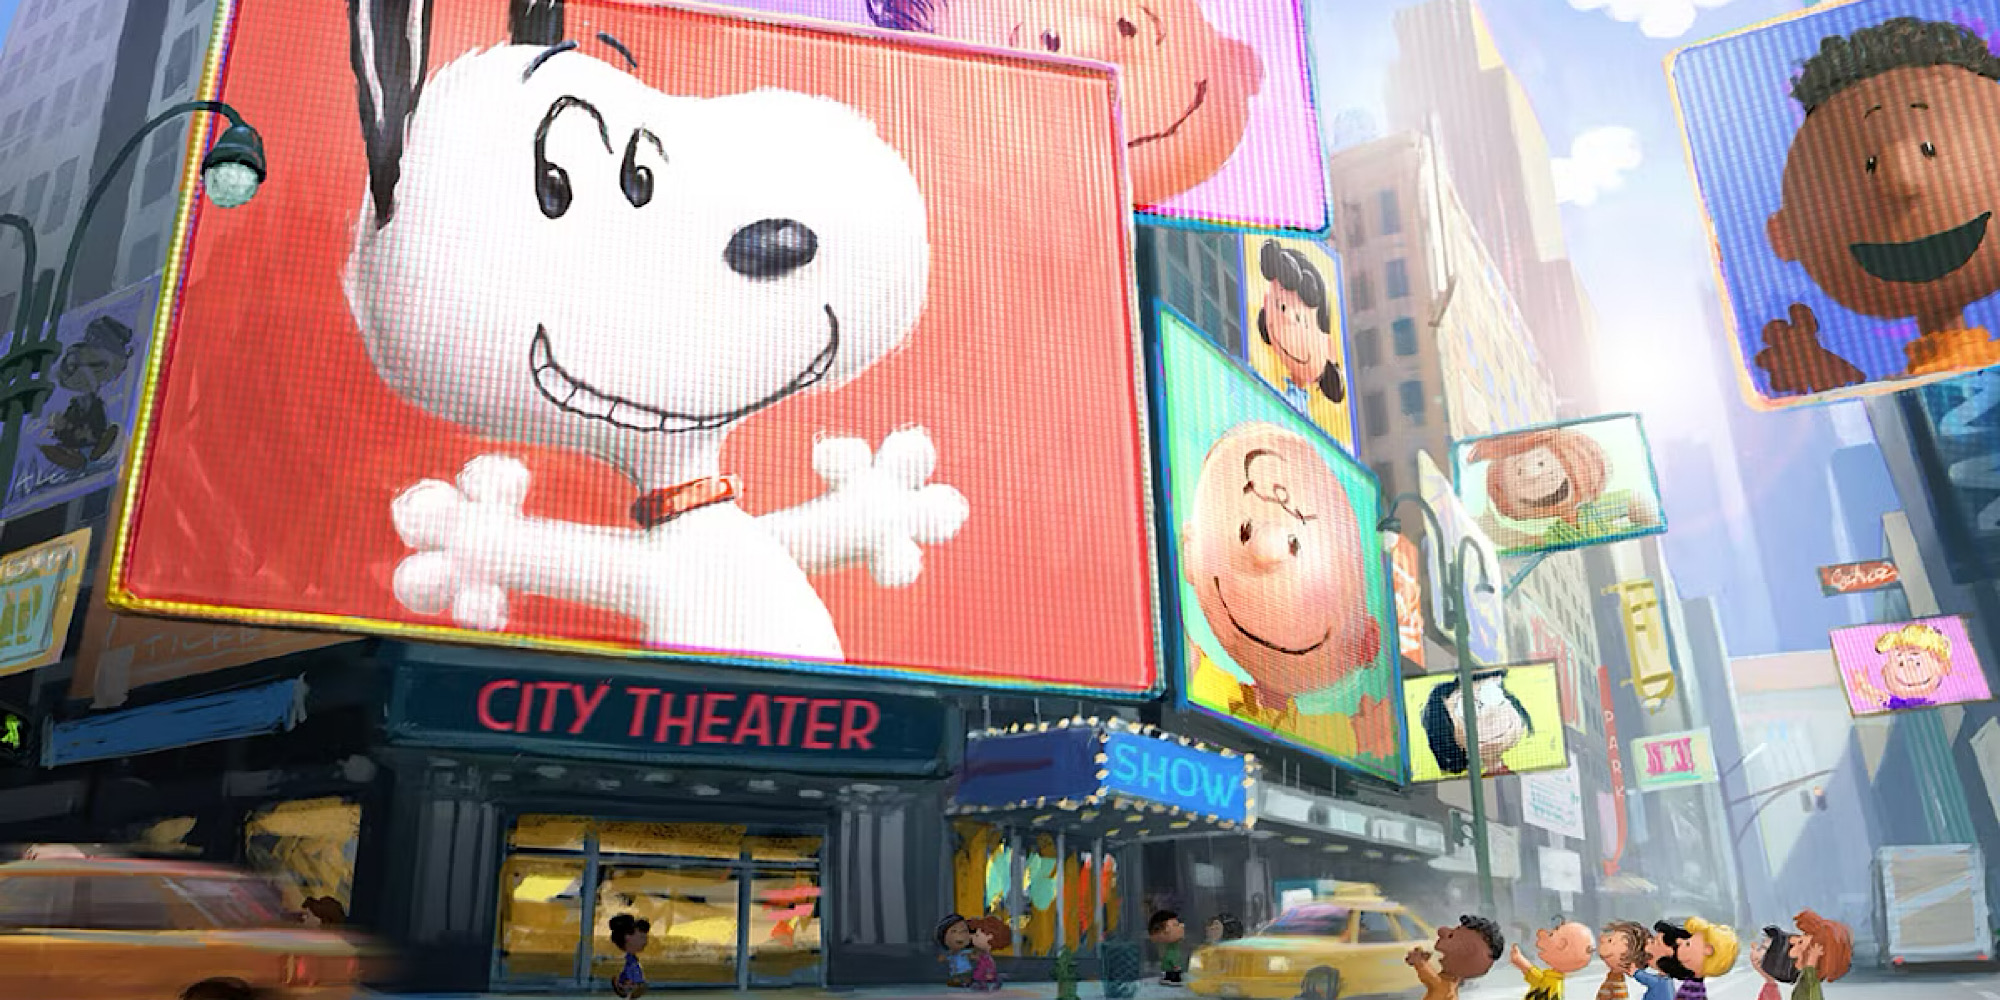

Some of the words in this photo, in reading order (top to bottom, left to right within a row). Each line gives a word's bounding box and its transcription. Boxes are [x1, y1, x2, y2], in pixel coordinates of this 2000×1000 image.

[476, 679, 611, 734] CITY
[625, 686, 881, 751] THEATER
[1112, 742, 1239, 807] SHOW
[1603, 709, 1625, 797] PARK
